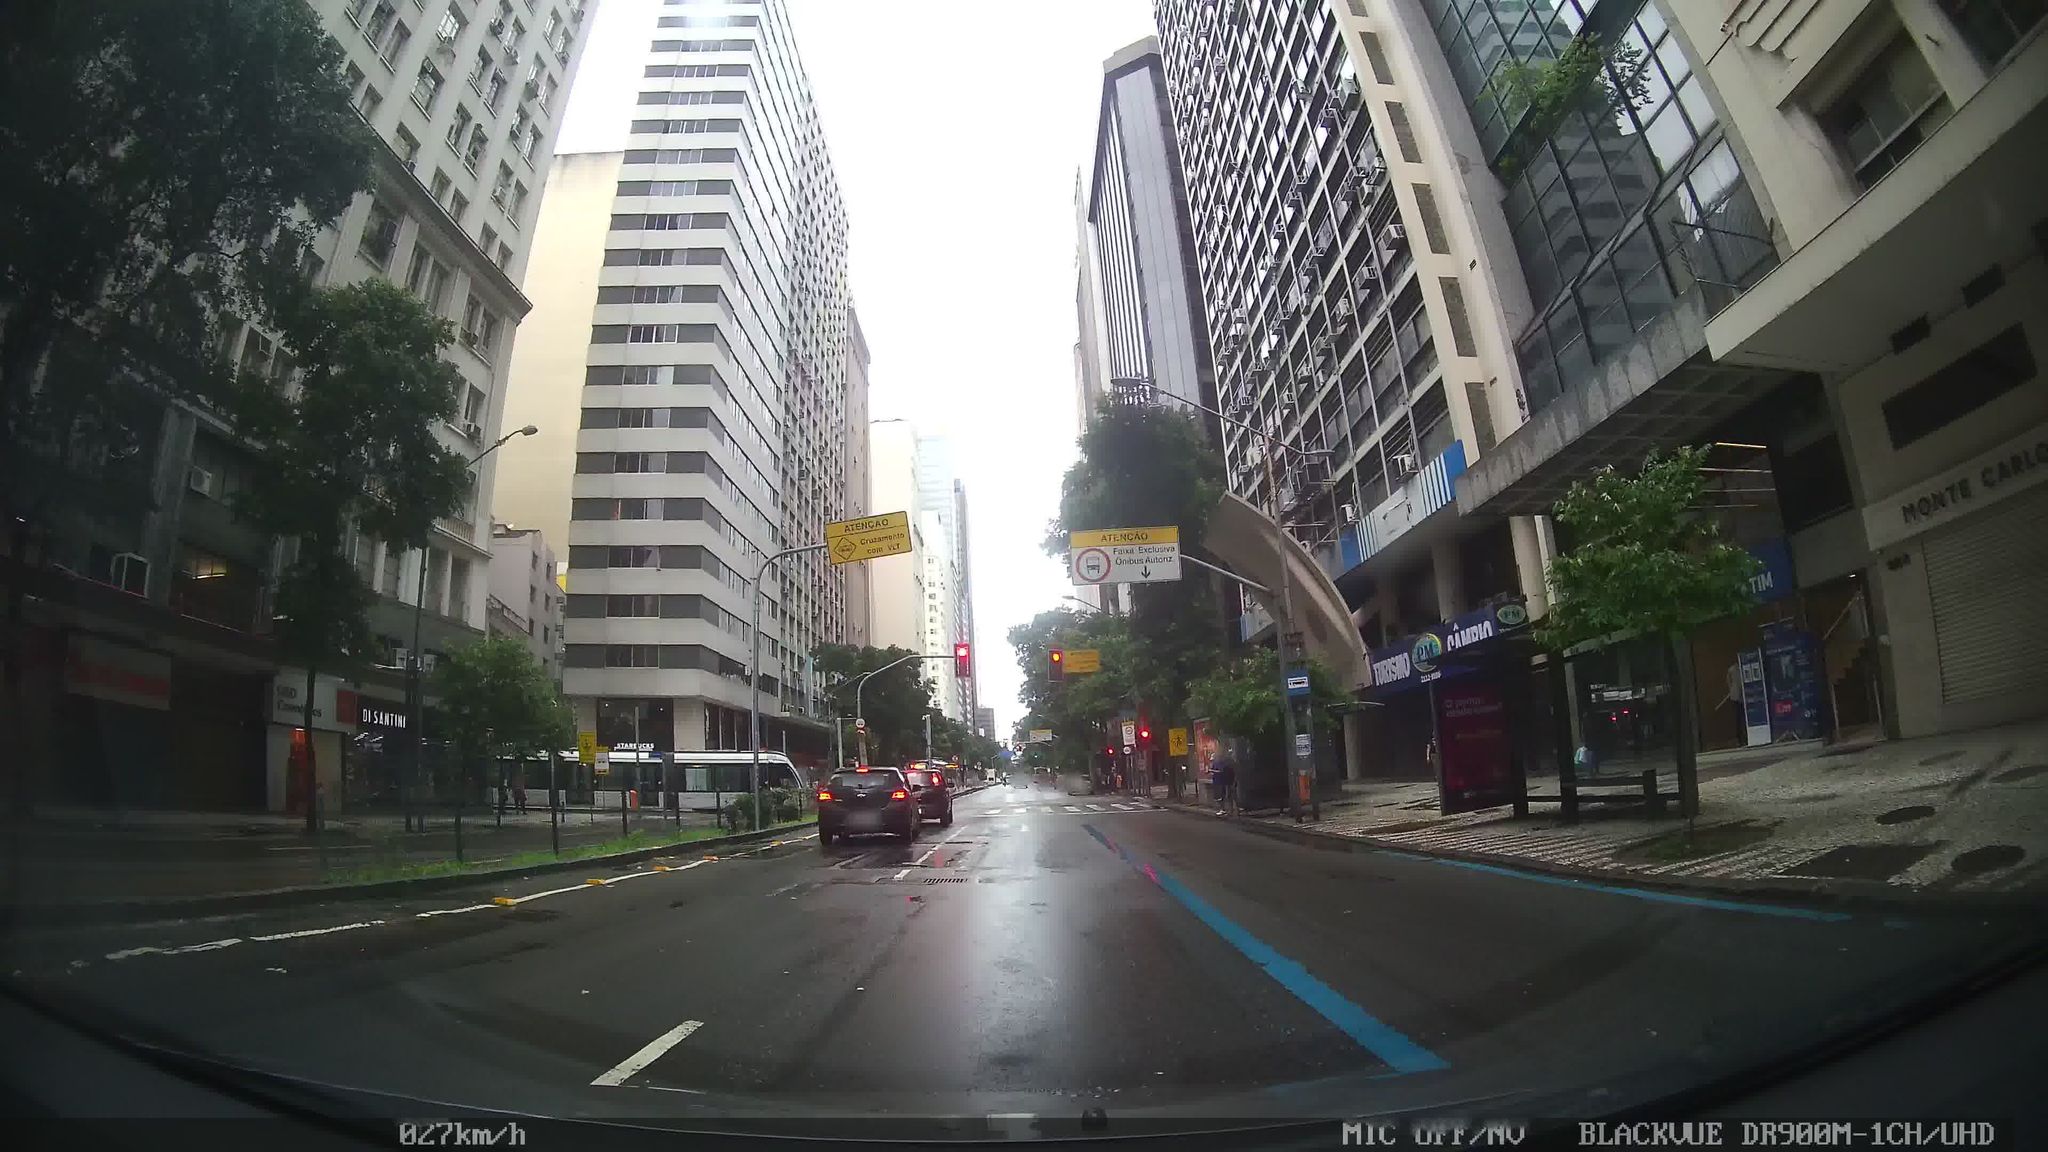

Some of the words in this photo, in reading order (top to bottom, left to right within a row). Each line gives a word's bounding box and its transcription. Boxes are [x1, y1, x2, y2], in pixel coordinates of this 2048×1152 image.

[1902, 478, 1972, 524] MONTE
[861, 532, 905, 546] Cruzamento
[1138, 545, 1175, 554] Exclusiva
[868, 547, 884, 555] com
[1749, 571, 1774, 594] TIM
[1446, 620, 1494, 652] CÂMBIO
[1373, 652, 1411, 687] TURISMO
[362, 708, 371, 723] DI
[374, 710, 407, 729] SANTINI
